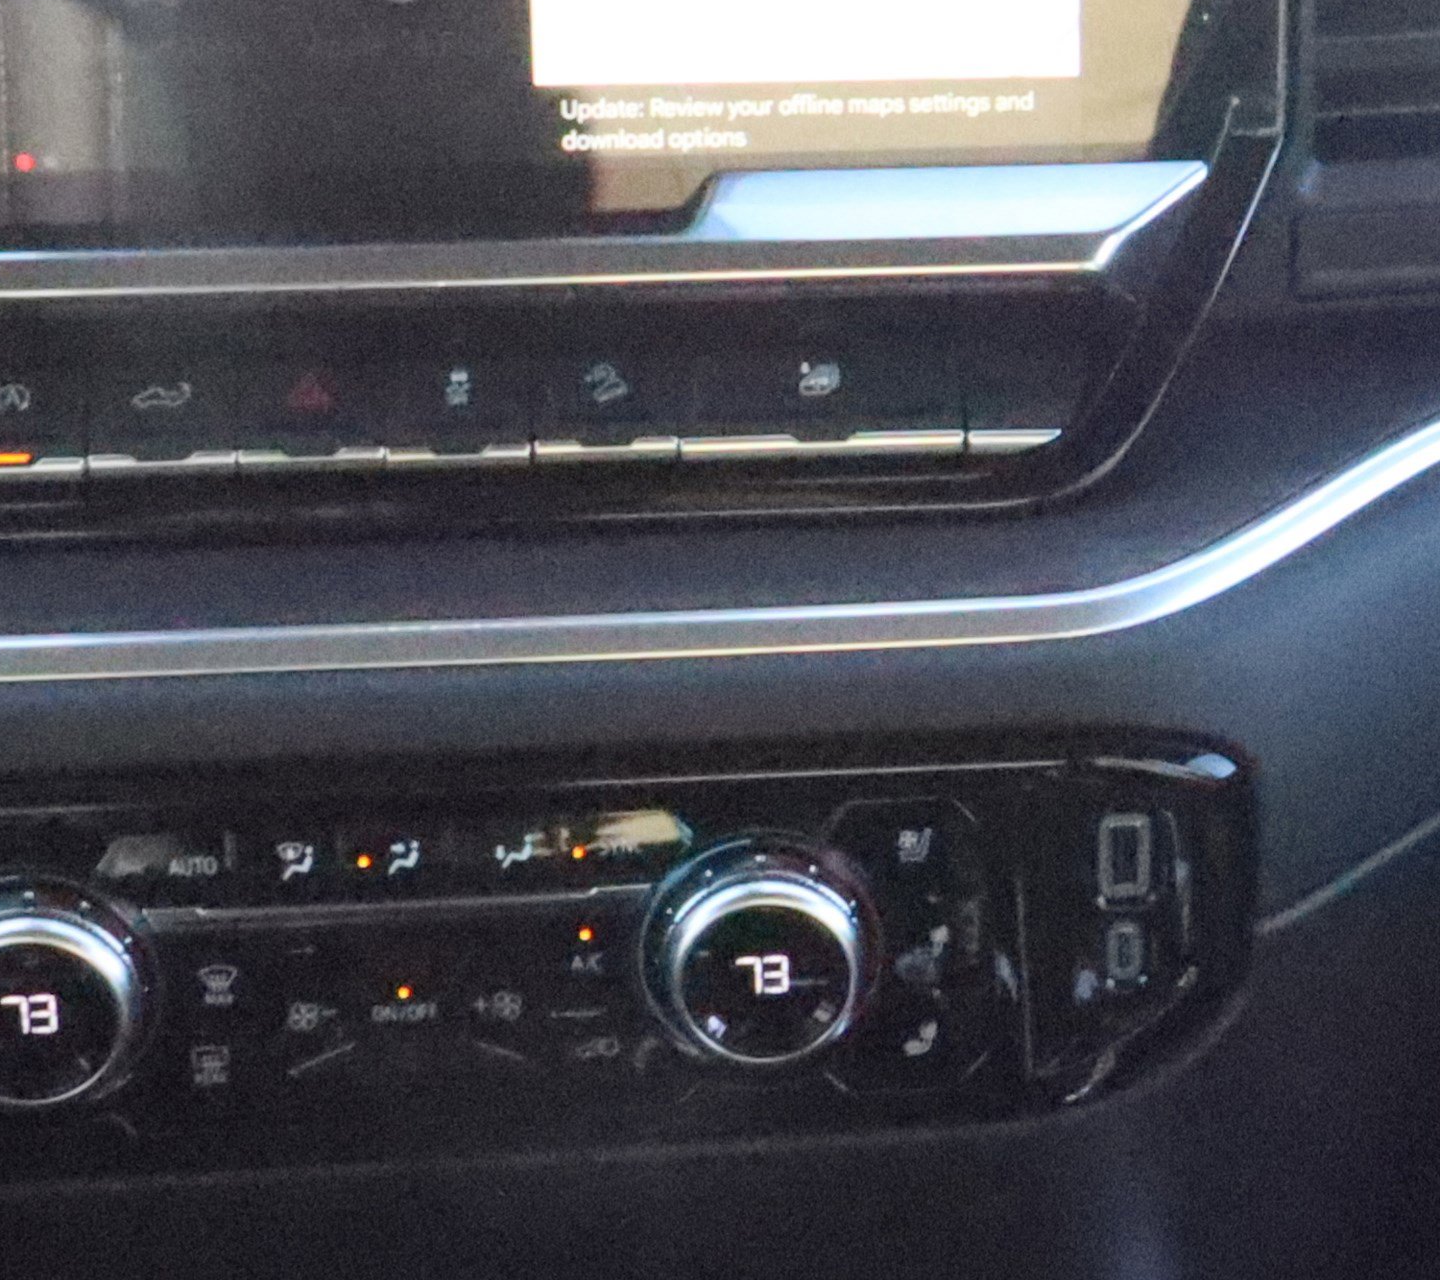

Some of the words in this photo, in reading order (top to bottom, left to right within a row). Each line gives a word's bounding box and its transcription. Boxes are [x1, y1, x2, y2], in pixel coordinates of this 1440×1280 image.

[561, 96, 645, 124] Update:
[650, 96, 724, 119] Review
[728, 98, 773, 120] your
[778, 93, 843, 117] offline
[848, 96, 905, 118] maps
[909, 92, 991, 118] settings
[995, 90, 1035, 113] and
[561, 128, 664, 152] download
[668, 126, 748, 153] options
[169, 856, 218, 878] AUTO
[735, 954, 791, 996] 73
[0, 993, 59, 1035] 73
